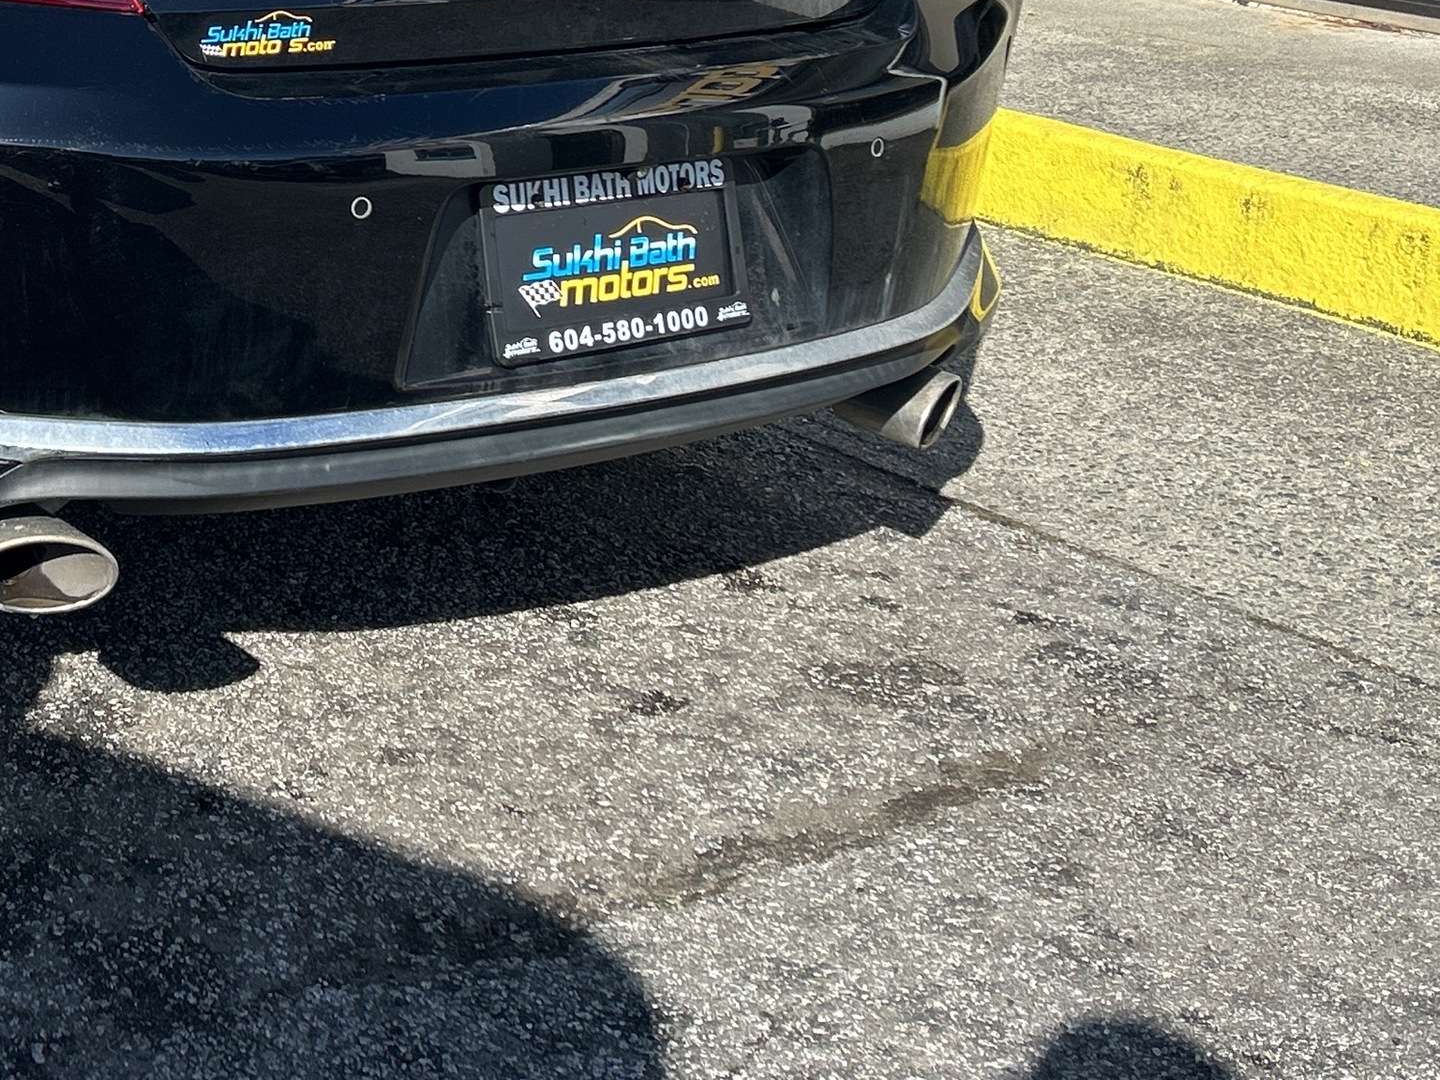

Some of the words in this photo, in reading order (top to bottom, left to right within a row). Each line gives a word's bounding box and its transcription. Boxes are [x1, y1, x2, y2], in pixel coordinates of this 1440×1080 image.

[201, 20, 264, 43] Sukhi
[266, 21, 311, 40] Bath
[492, 177, 571, 214] SUKHI
[573, 172, 633, 205] BATH
[637, 158, 725, 195] MOTORS
[522, 233, 622, 282] Sukhi
[629, 230, 697, 268] Bath
[548, 305, 710, 354] 604-580-1000
